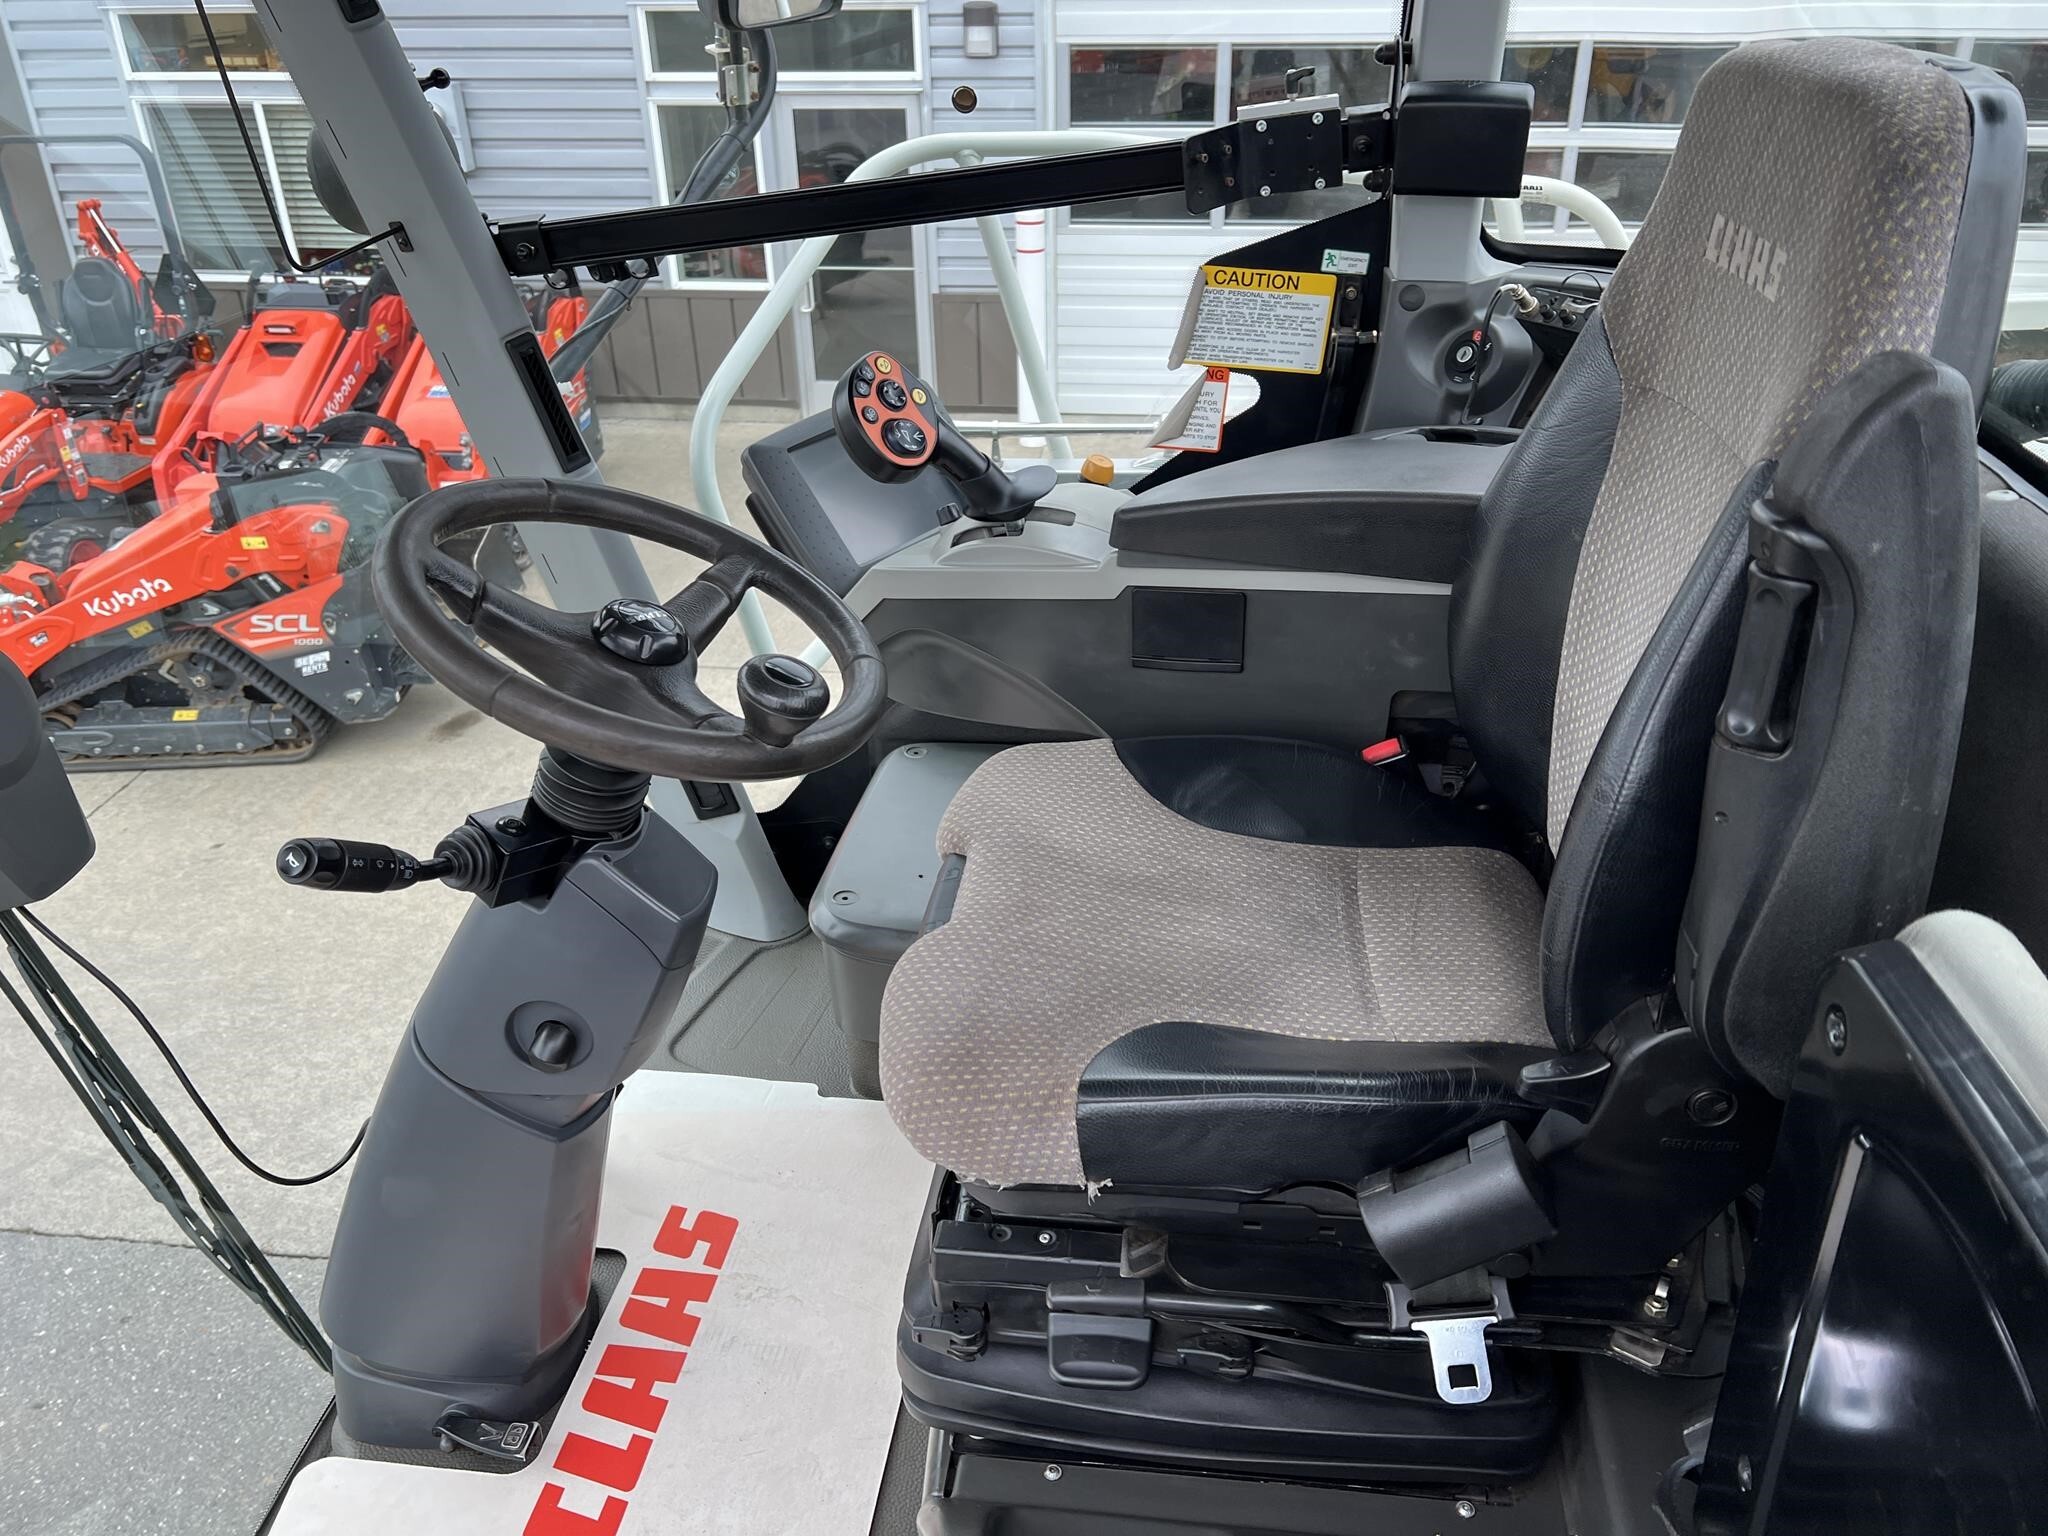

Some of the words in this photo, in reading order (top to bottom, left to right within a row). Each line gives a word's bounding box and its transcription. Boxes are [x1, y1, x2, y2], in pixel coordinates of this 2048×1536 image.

[1703, 211, 1787, 303] CLAAS
[1204, 288, 1226, 296] AVOID
[1228, 290, 1265, 299] PERSONAL
[1268, 293, 1294, 301] INJURY
[1213, 269, 1301, 291] CAUTION
[323, 374, 356, 419] Kubota
[82, 578, 173, 616] Kubota
[249, 614, 320, 633] SCL
[294, 638, 323, 646] 1000
[522, 1205, 739, 1536] CLAAS
